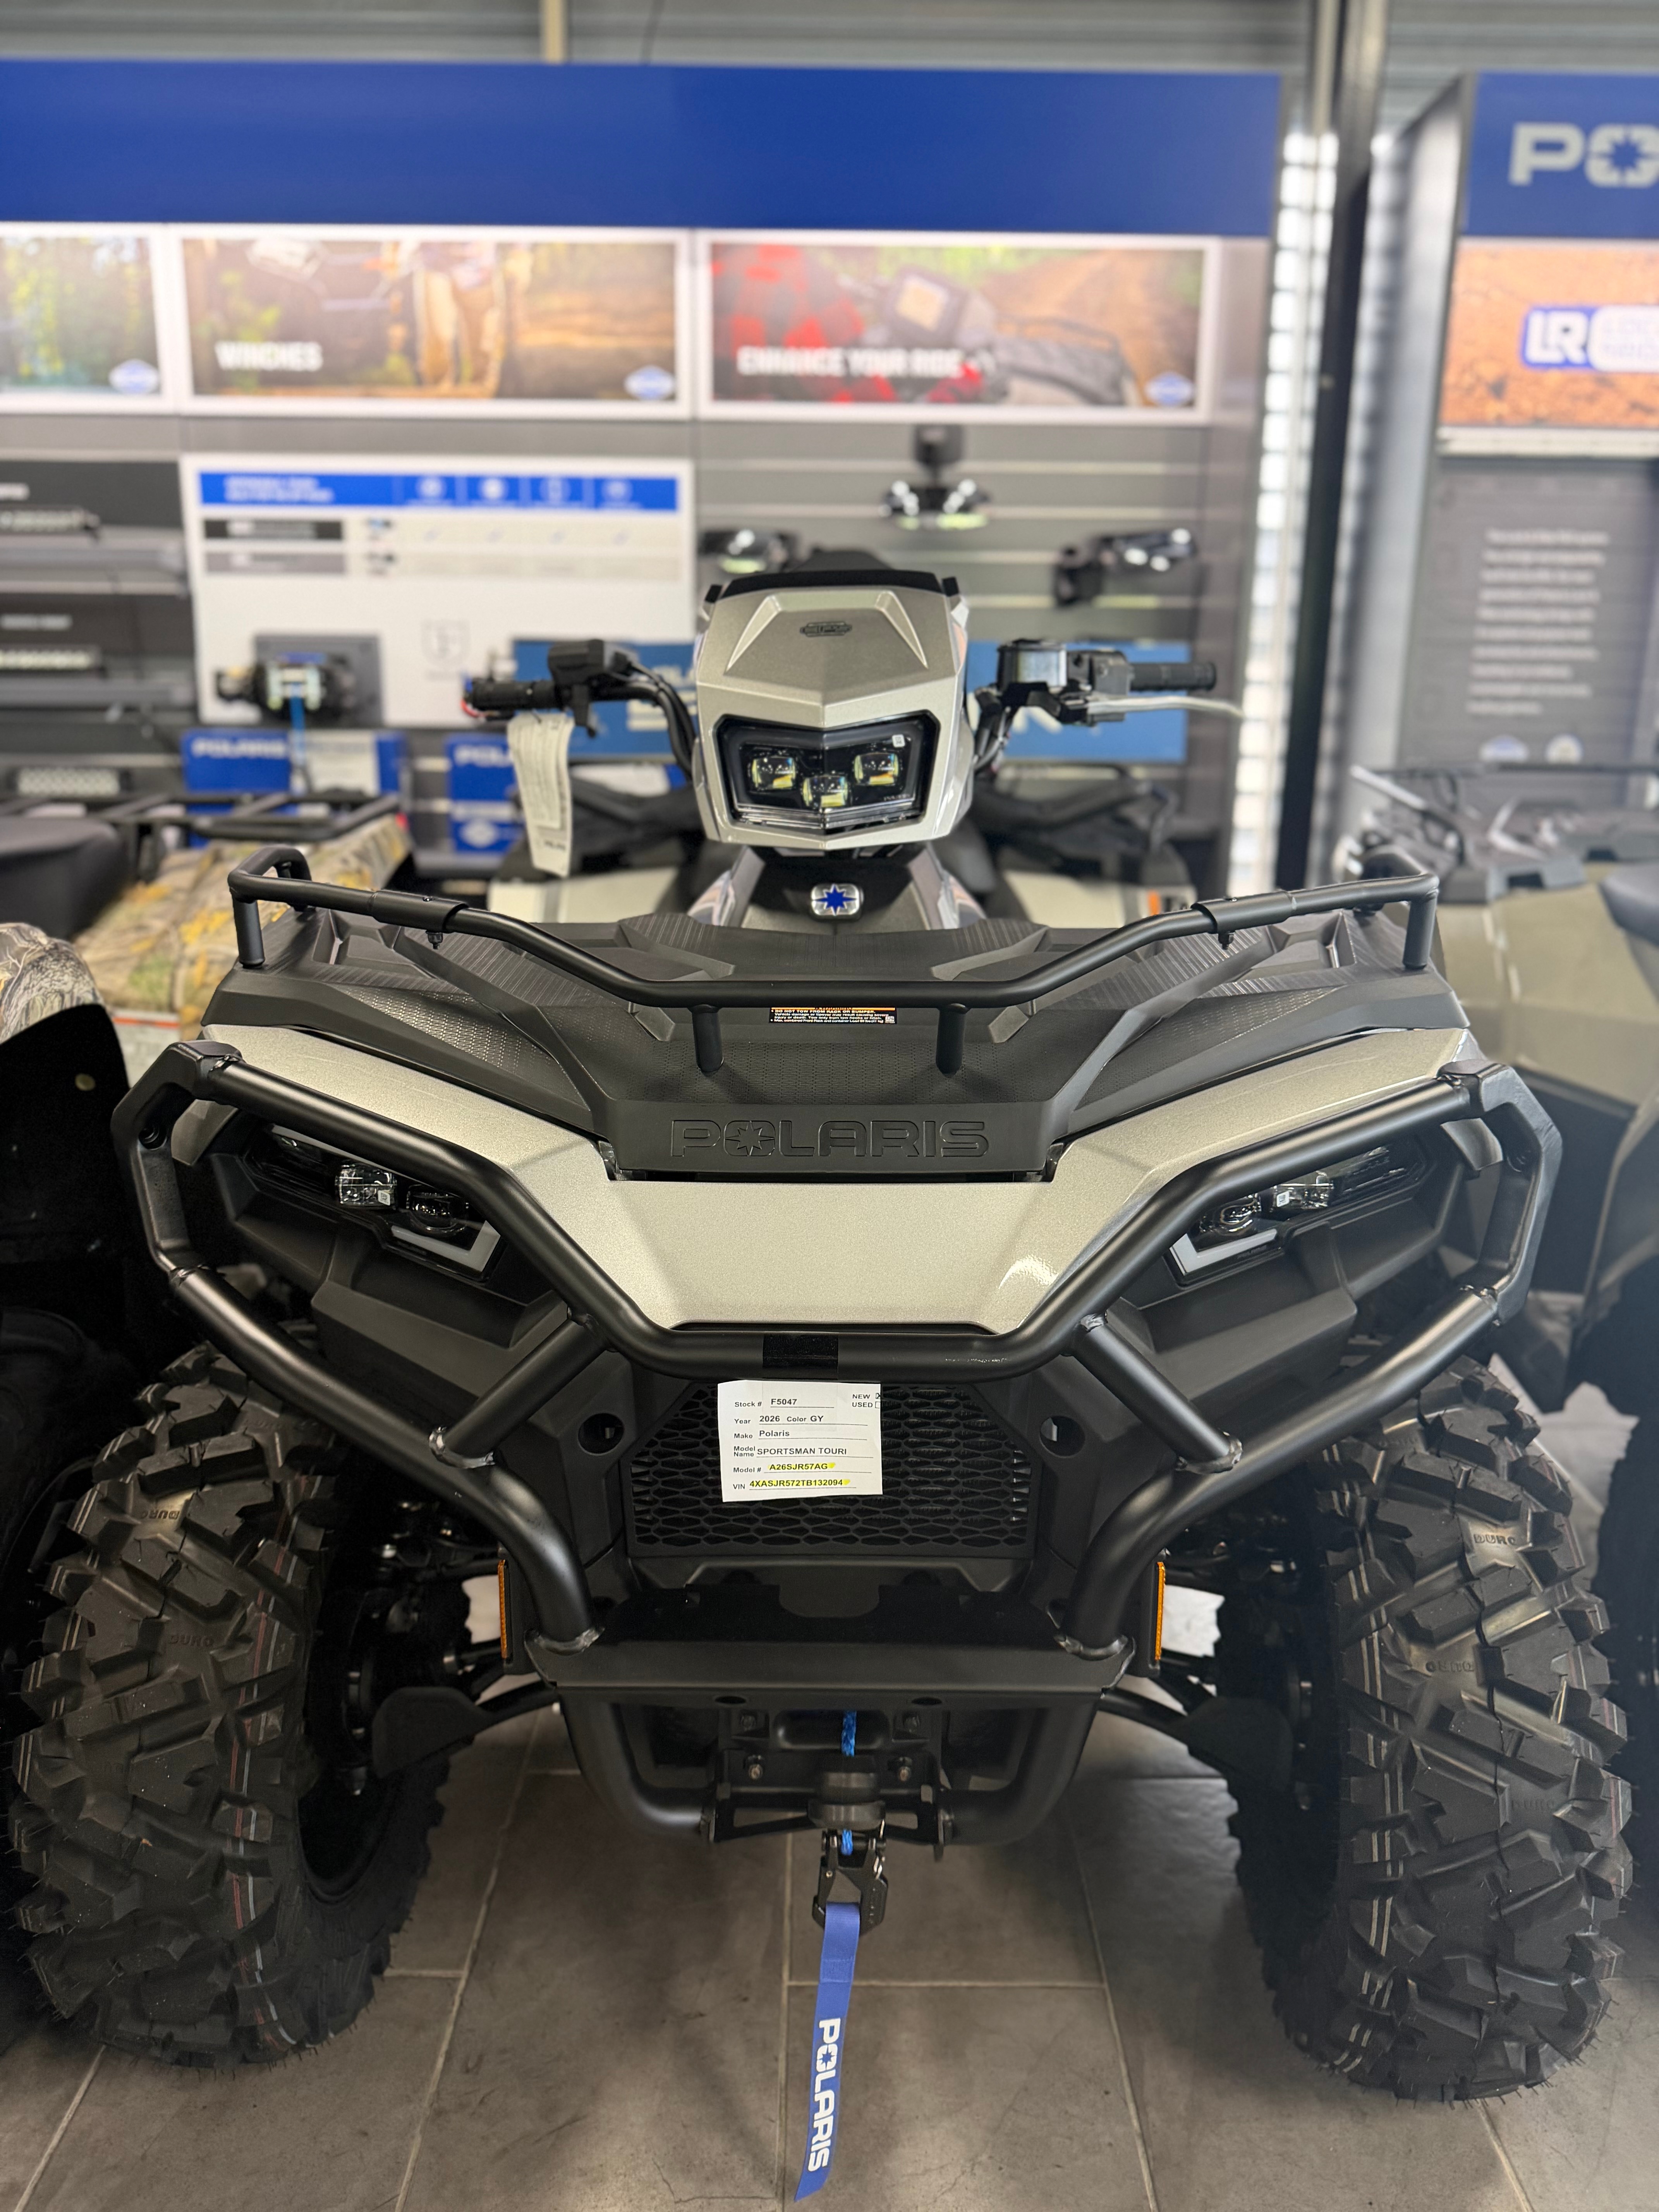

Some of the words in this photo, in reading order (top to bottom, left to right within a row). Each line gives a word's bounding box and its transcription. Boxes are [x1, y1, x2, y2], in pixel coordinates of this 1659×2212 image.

[670, 1120, 989, 1158] POLARIS
[749, 1479, 843, 1487] 4XASJR572TB132094
[1473, 1534, 1517, 1546] DURO
[808, 2018, 841, 2172] POLARIS
